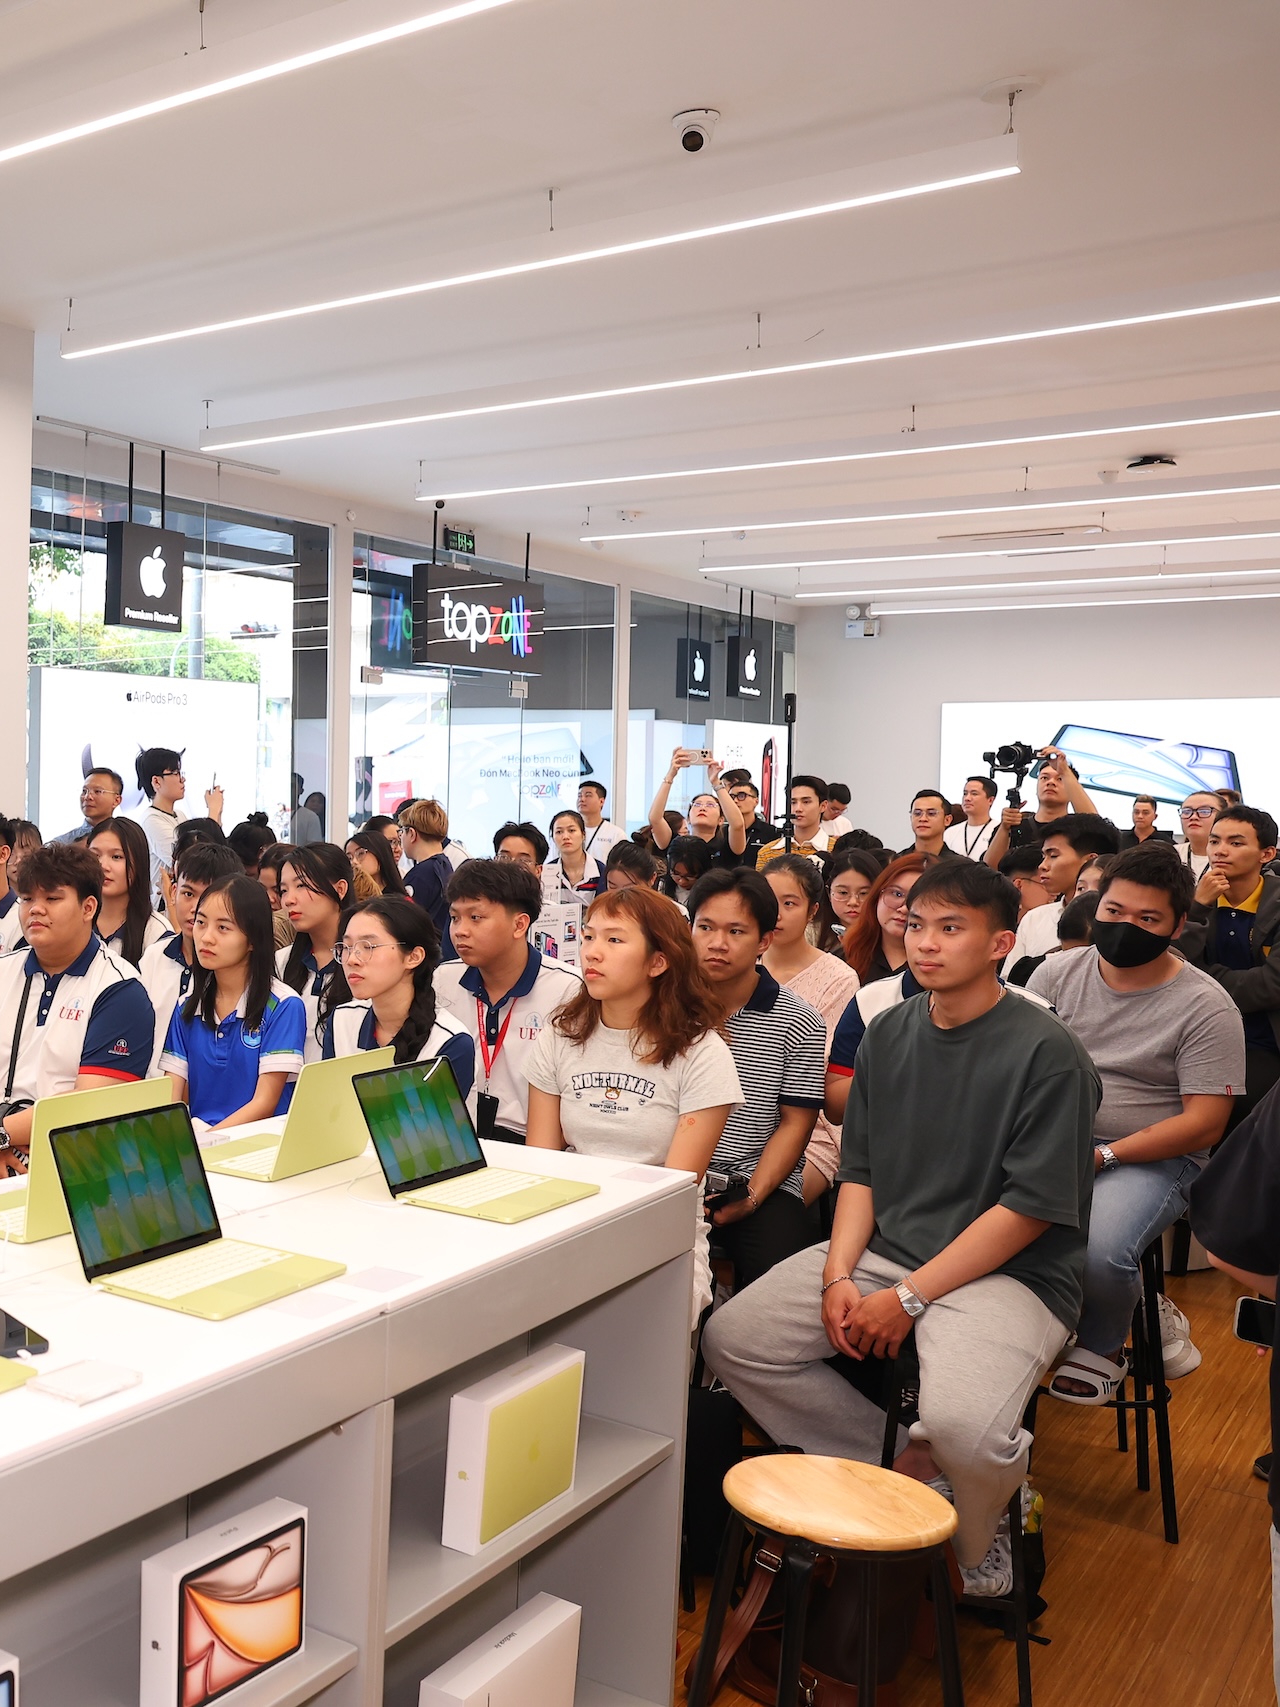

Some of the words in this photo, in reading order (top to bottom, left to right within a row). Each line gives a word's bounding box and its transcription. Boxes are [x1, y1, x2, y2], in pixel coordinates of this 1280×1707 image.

[133, 691, 166, 704] AirPods
[167, 692, 181, 705] Pro
[182, 694, 188, 705] 3
[542, 768, 561, 778] Neo
[59, 1006, 84, 1021] UEF
[571, 1072, 656, 1099] NOCTURNAL
